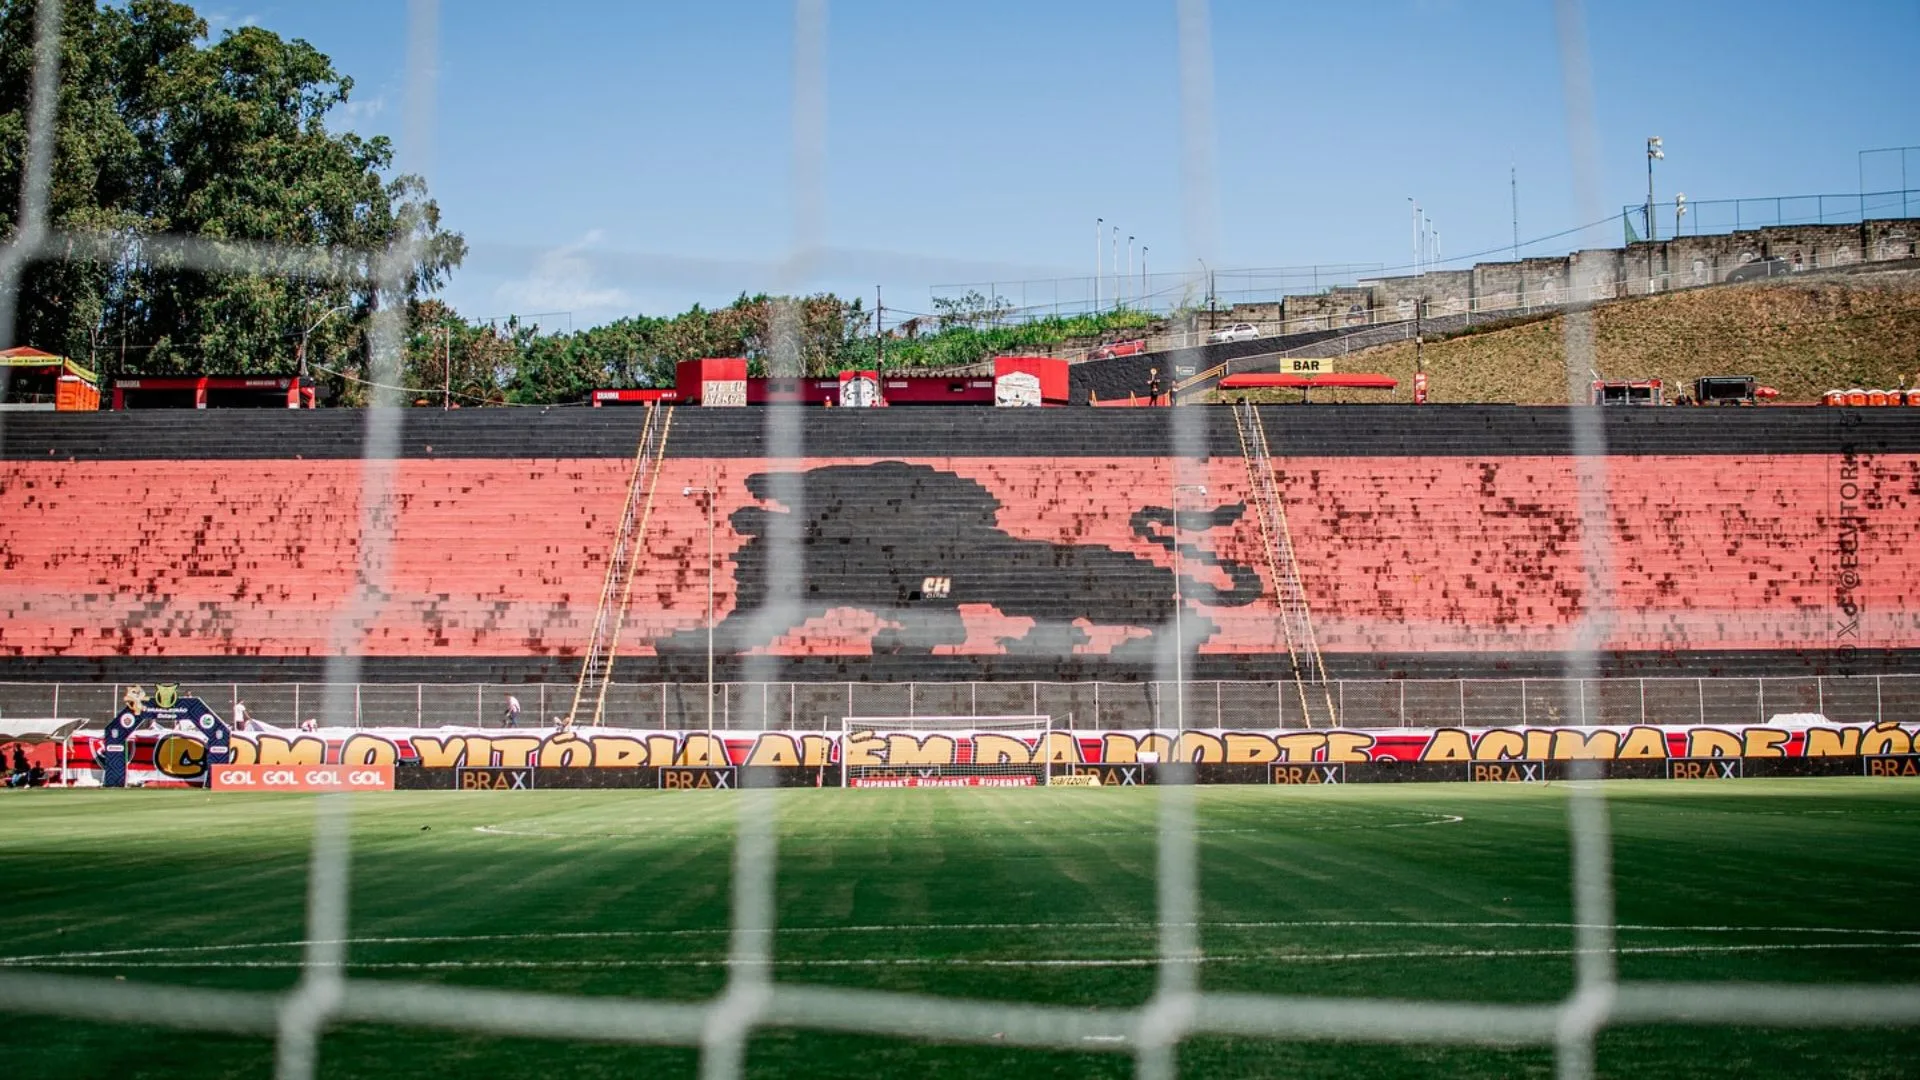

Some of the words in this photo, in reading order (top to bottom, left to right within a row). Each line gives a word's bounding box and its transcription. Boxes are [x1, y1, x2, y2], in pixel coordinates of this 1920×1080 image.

[1292, 361, 1320, 371] BAR
[971, 731, 1086, 765] DA
[1687, 727, 1791, 758] DE
[1804, 721, 1920, 757] NÓ
[1274, 765, 1338, 784] BRAX
[1474, 764, 1536, 782] BRAX
[1674, 762, 1735, 779] BRAX
[1871, 758, 1920, 777] BRA
[219, 770, 256, 785] GOL
[262, 770, 298, 785] GOL
[305, 770, 341, 785] GOL
[348, 770, 385, 785] GOL
[462, 770, 527, 790] BRAX
[664, 769, 731, 789] BRAX
